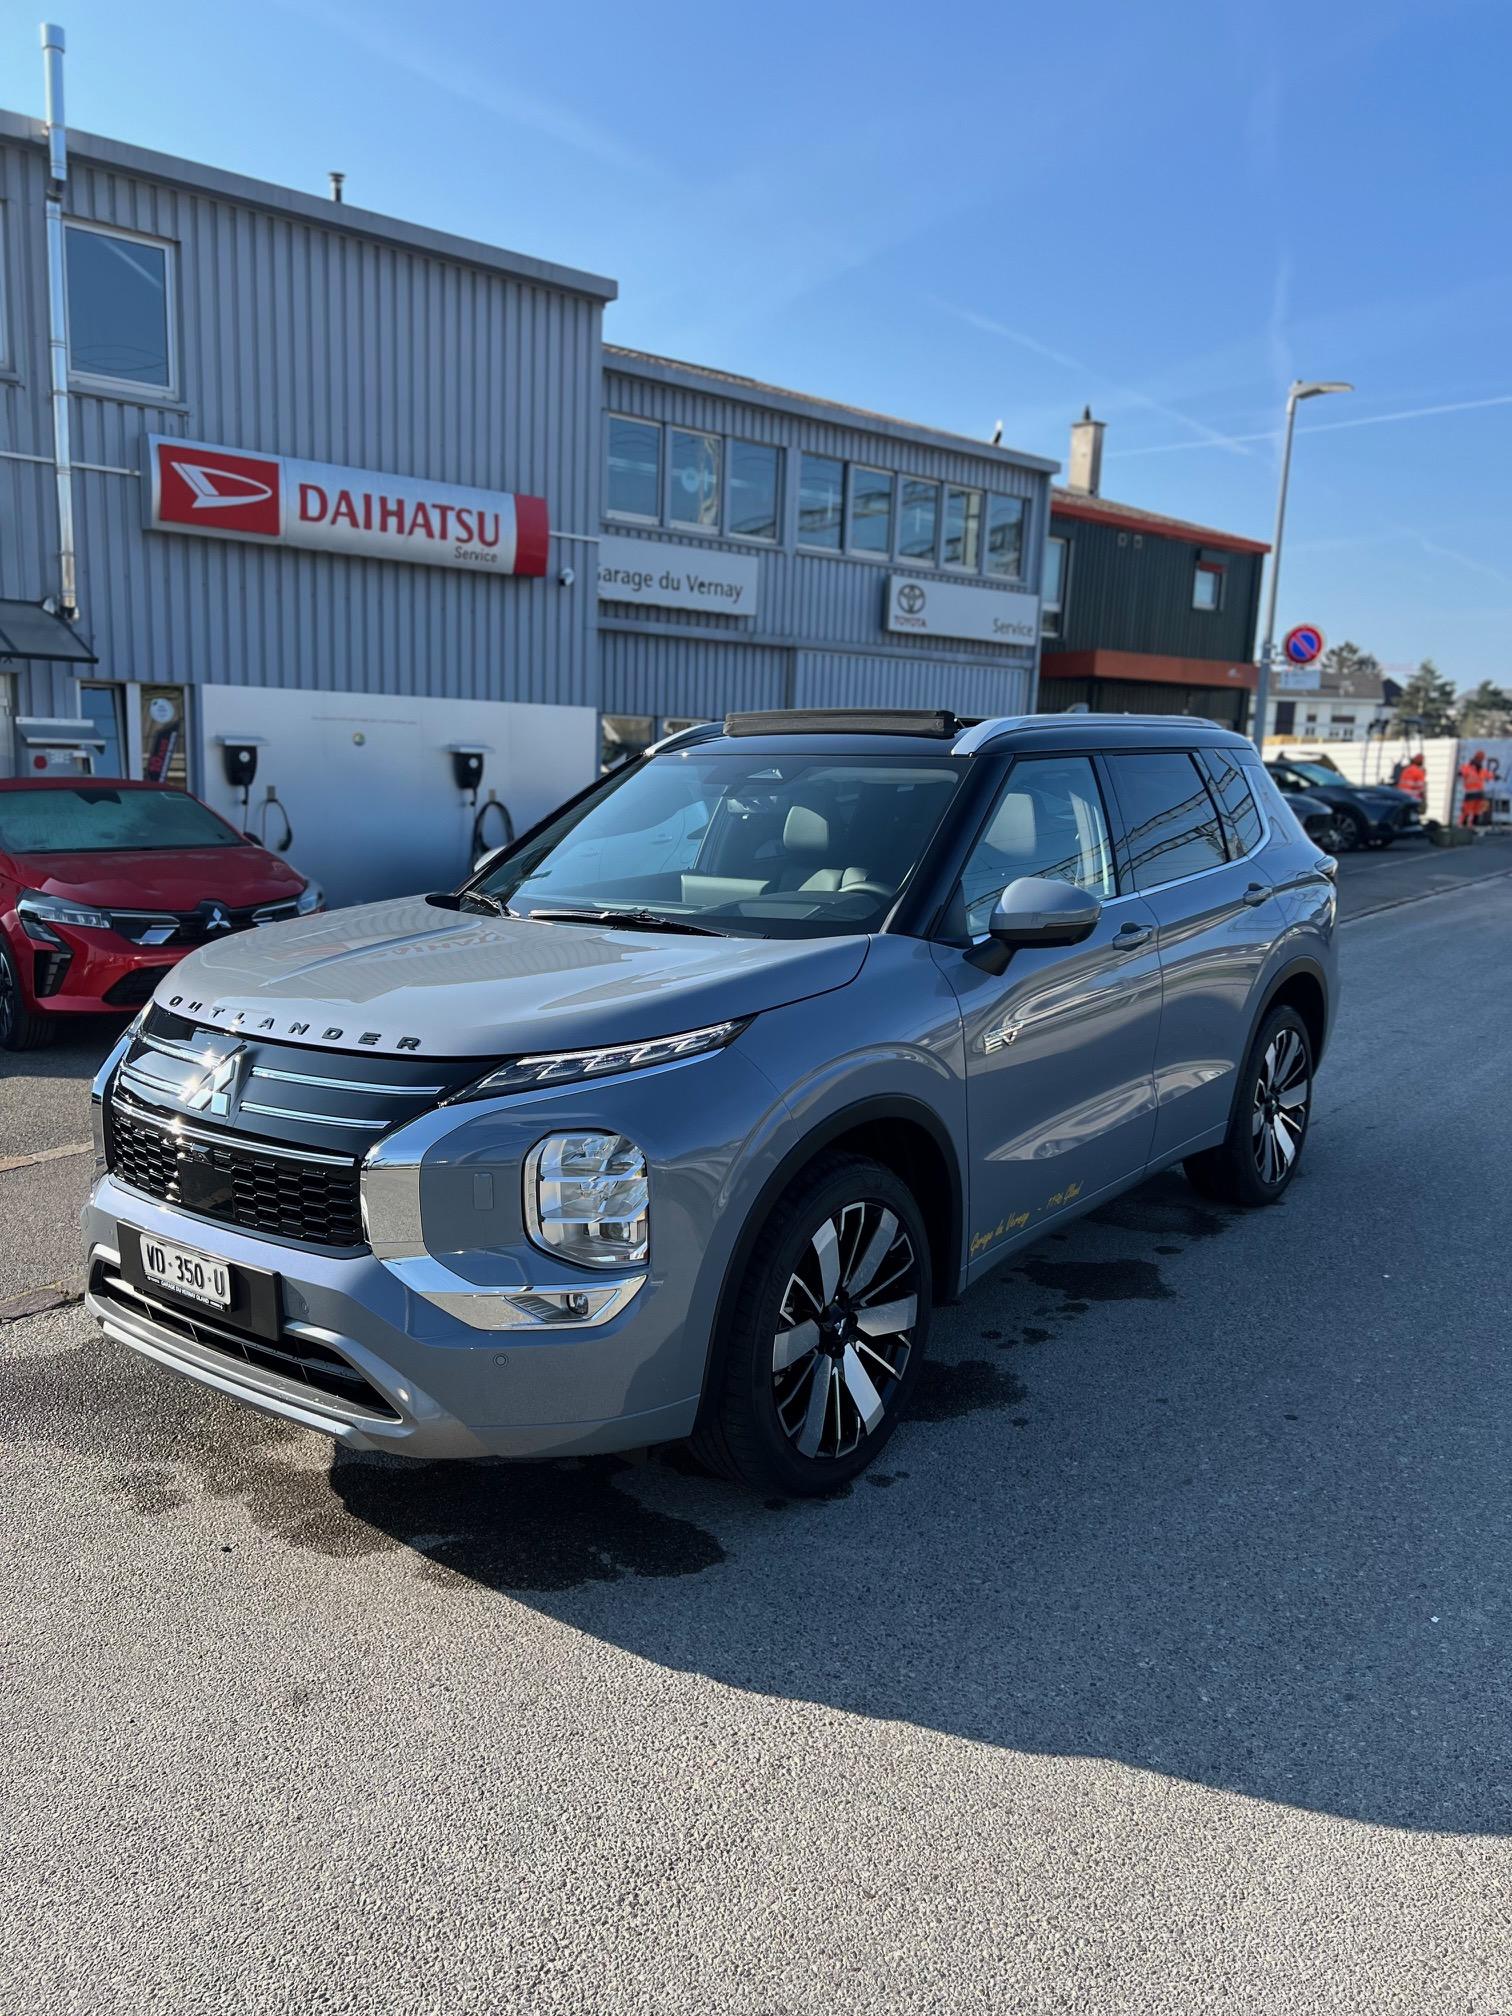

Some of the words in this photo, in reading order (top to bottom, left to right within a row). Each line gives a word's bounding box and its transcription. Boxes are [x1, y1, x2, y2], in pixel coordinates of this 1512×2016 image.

[298, 482, 500, 548] DAIHATSU
[453, 546, 498, 564] Service
[658, 571, 681, 592] du
[686, 574, 744, 604] Vernay
[895, 615, 928, 629] TOYOTA
[992, 617, 1034, 638] Service
[168, 995, 422, 1051] OUTLANDER
[146, 1244, 166, 1274] VD
